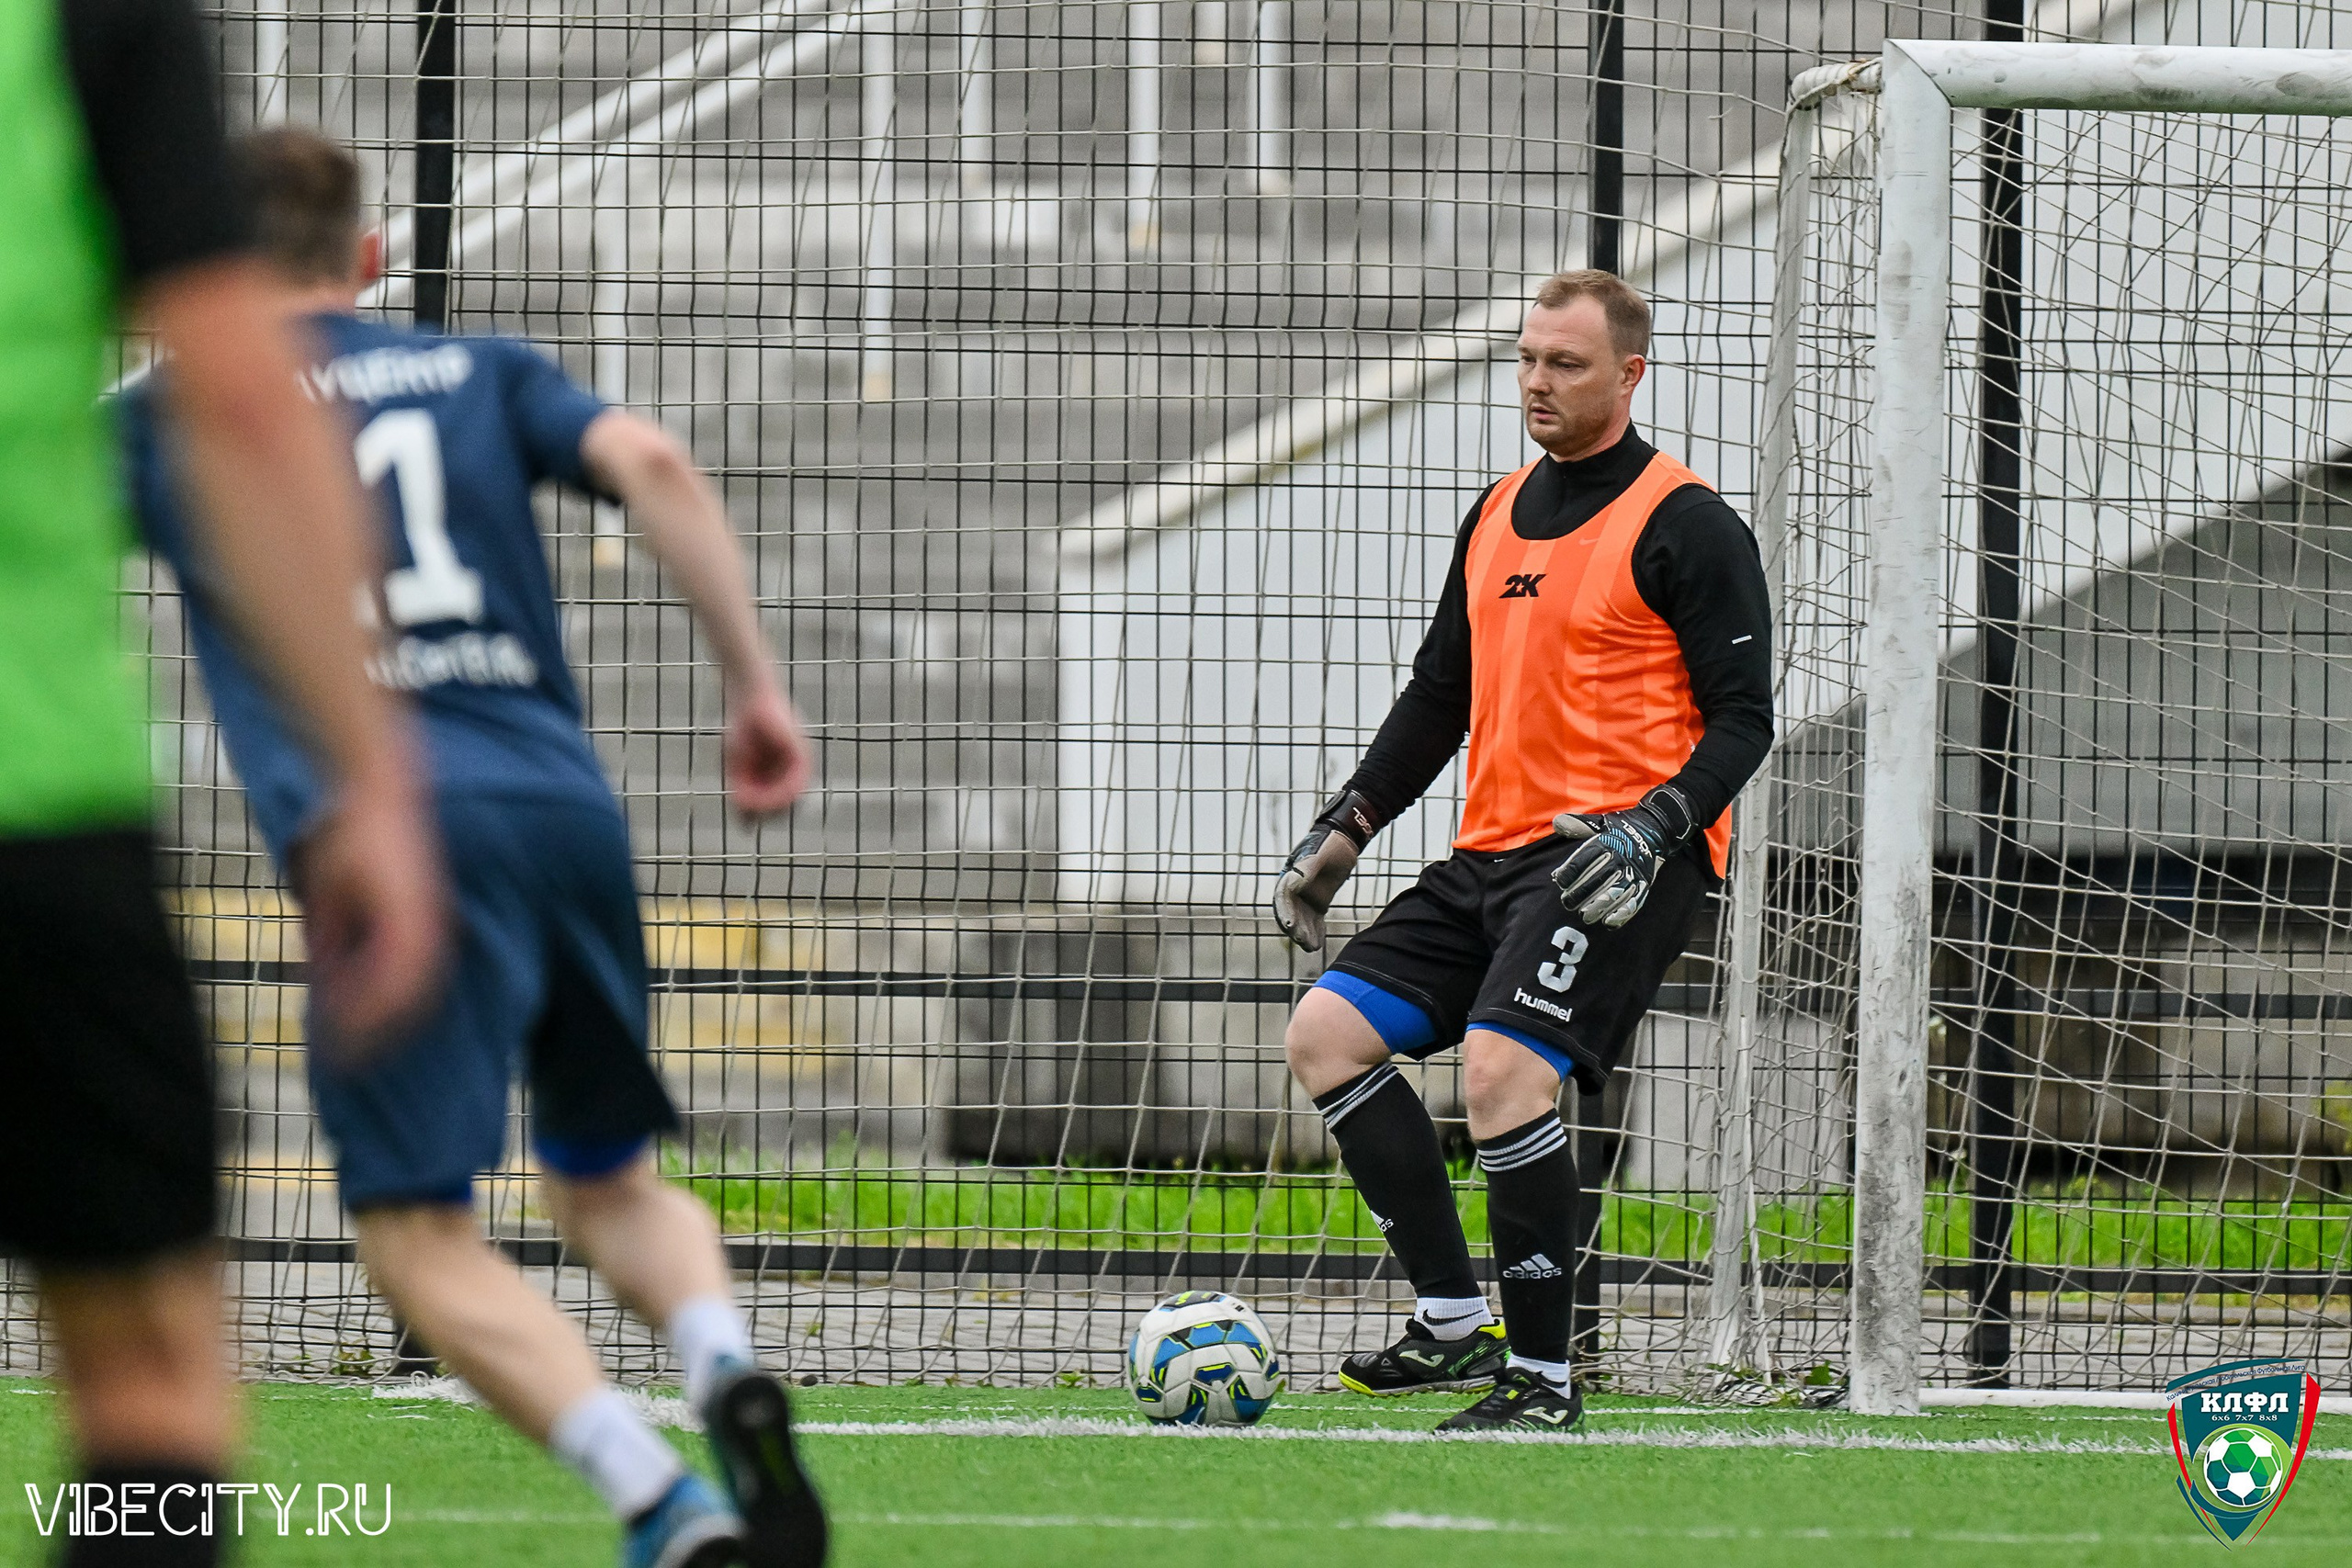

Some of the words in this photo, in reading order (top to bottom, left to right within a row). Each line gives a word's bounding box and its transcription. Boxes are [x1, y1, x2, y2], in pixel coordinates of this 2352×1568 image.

[1498, 573, 1547, 599] 2K
[1537, 926, 1589, 993] 3
[1513, 987, 1573, 1022] hummel
